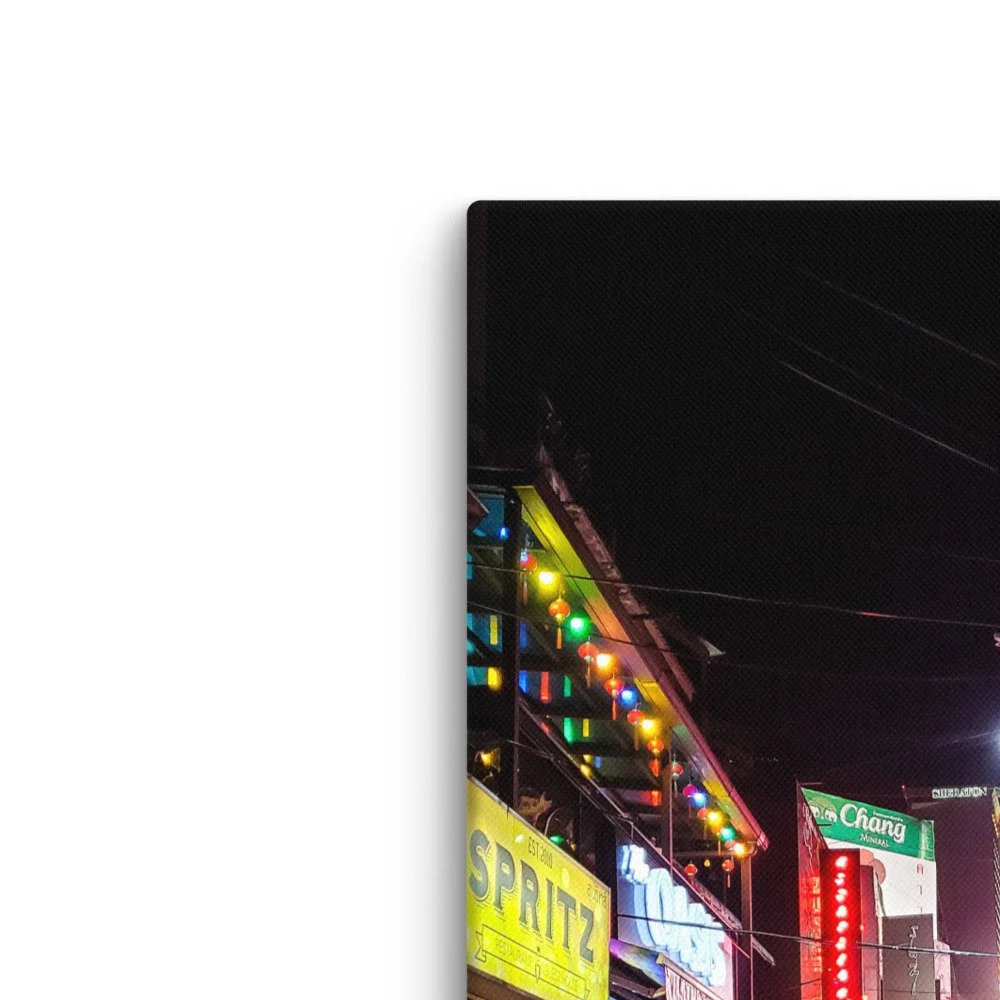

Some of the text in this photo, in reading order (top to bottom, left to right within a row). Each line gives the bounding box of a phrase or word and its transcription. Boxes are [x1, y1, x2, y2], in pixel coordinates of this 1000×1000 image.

[931, 785, 988, 799] SHERATON
[839, 802, 907, 844] Chang
[468, 828, 595, 964] SPRITZ
